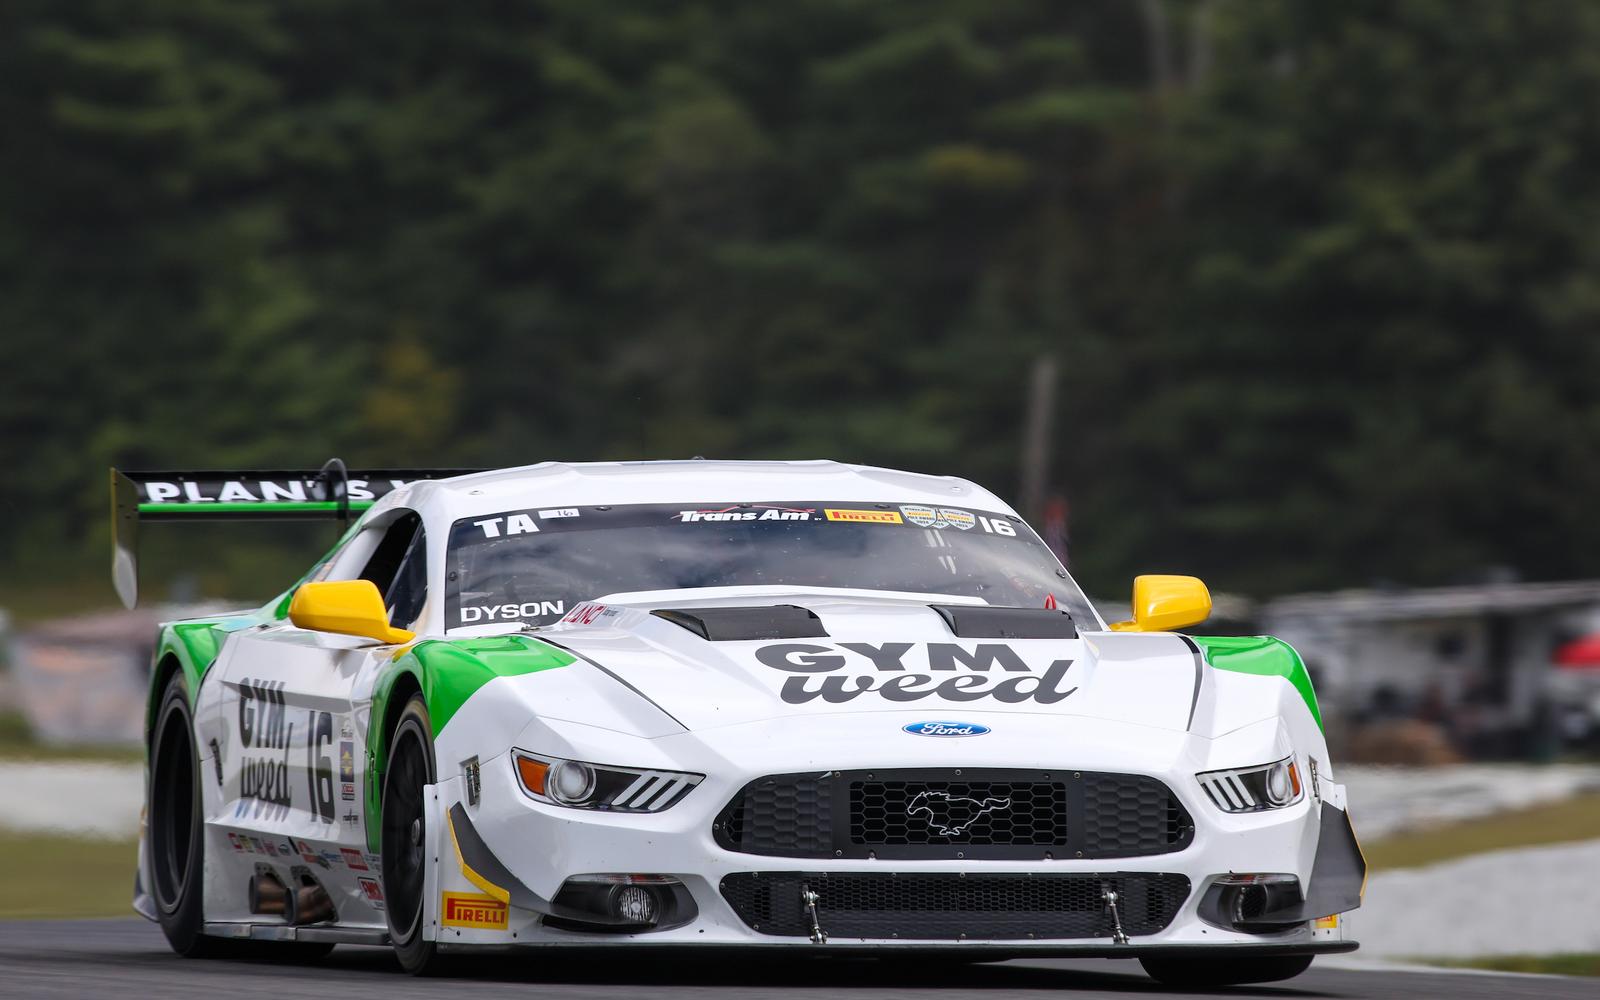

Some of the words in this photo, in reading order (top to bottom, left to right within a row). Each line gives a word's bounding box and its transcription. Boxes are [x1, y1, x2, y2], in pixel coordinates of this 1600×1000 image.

[144, 480, 375, 502] PLANS
[473, 514, 539, 538] TA
[679, 510, 757, 522] Trans
[758, 509, 809, 521] Am
[832, 510, 897, 522] PIRELLI
[978, 516, 1017, 537] 16
[460, 600, 564, 623] DYSON
[754, 642, 1031, 673] GYM
[779, 659, 1079, 705] weed
[238, 677, 286, 750] GYM
[919, 722, 974, 735] Ford
[240, 722, 292, 808] weed
[307, 710, 335, 824] 16
[446, 897, 507, 924] PIRELLI
